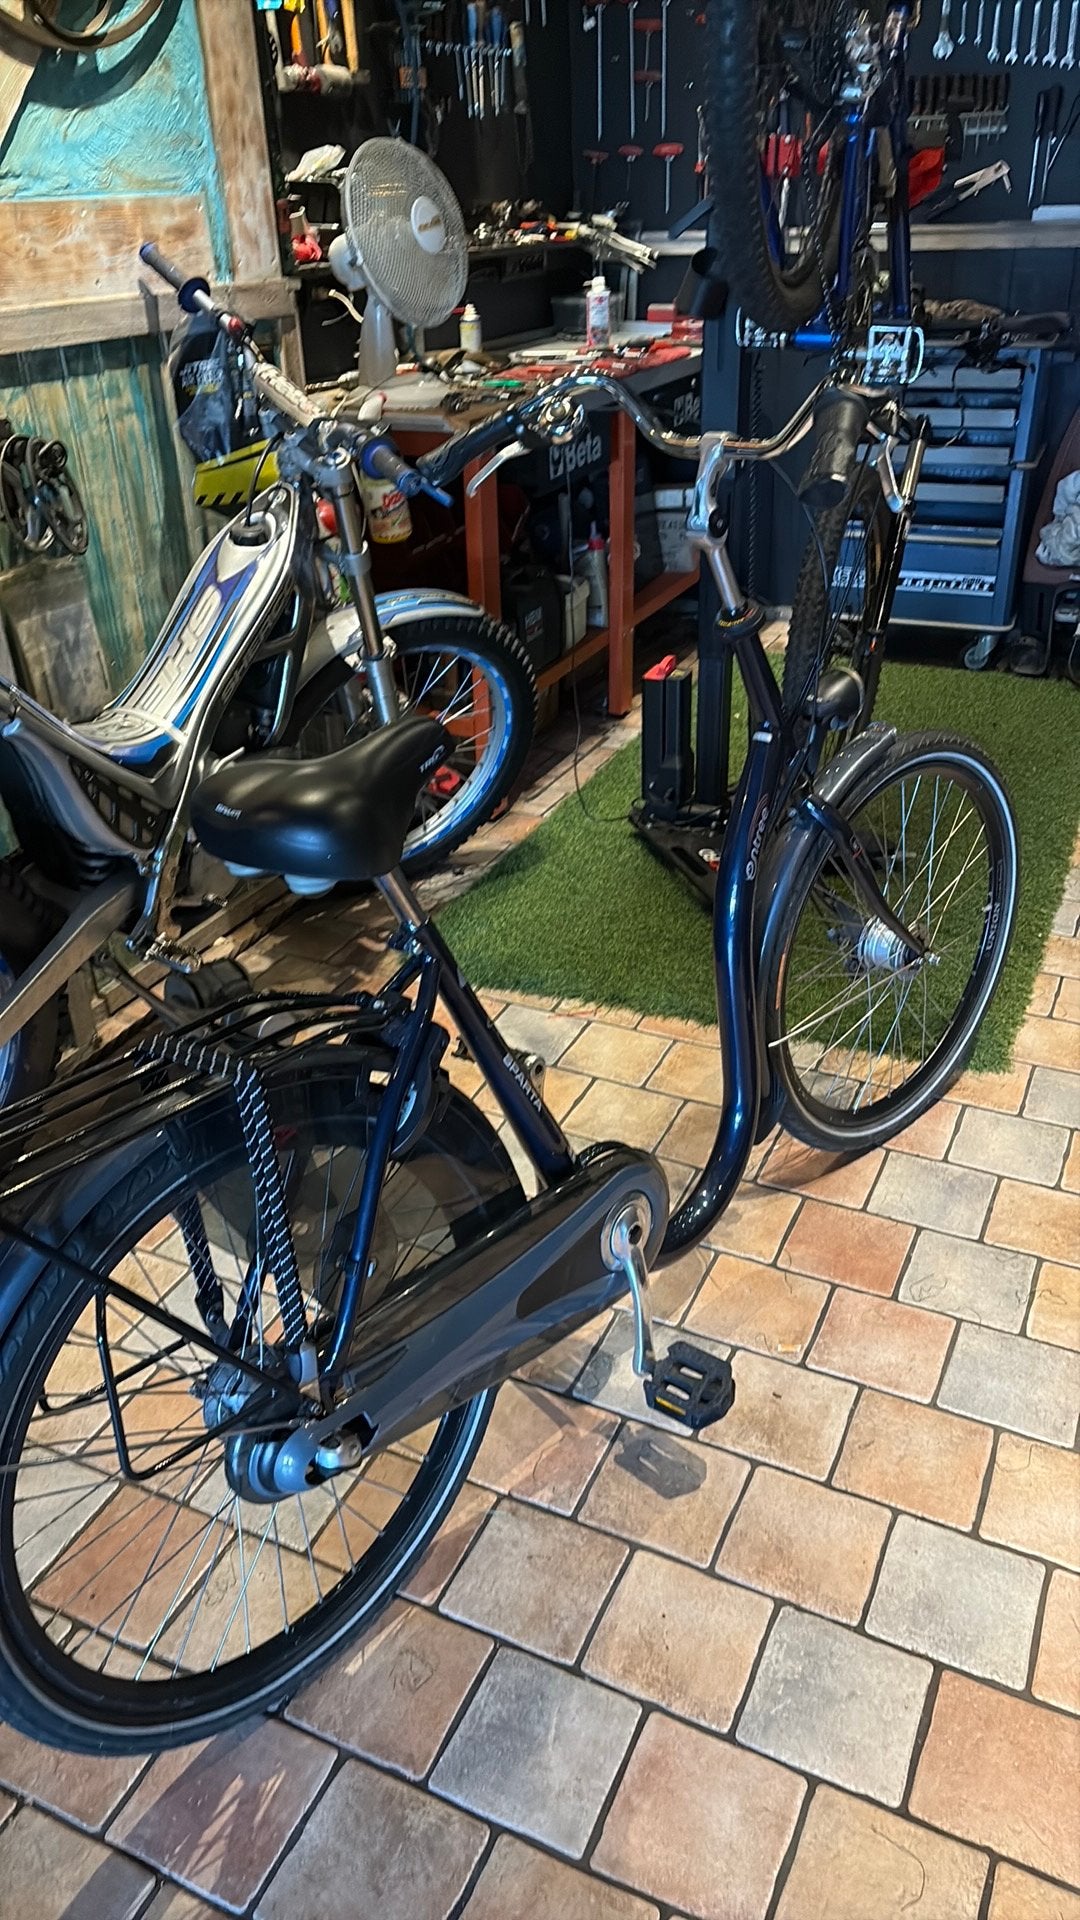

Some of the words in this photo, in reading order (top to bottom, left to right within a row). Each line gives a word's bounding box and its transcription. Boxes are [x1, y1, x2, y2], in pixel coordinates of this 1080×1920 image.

[565, 432, 602, 473] Beta
[986, 902, 1001, 951] UNION
[502, 1052, 543, 1113] SPARTA
